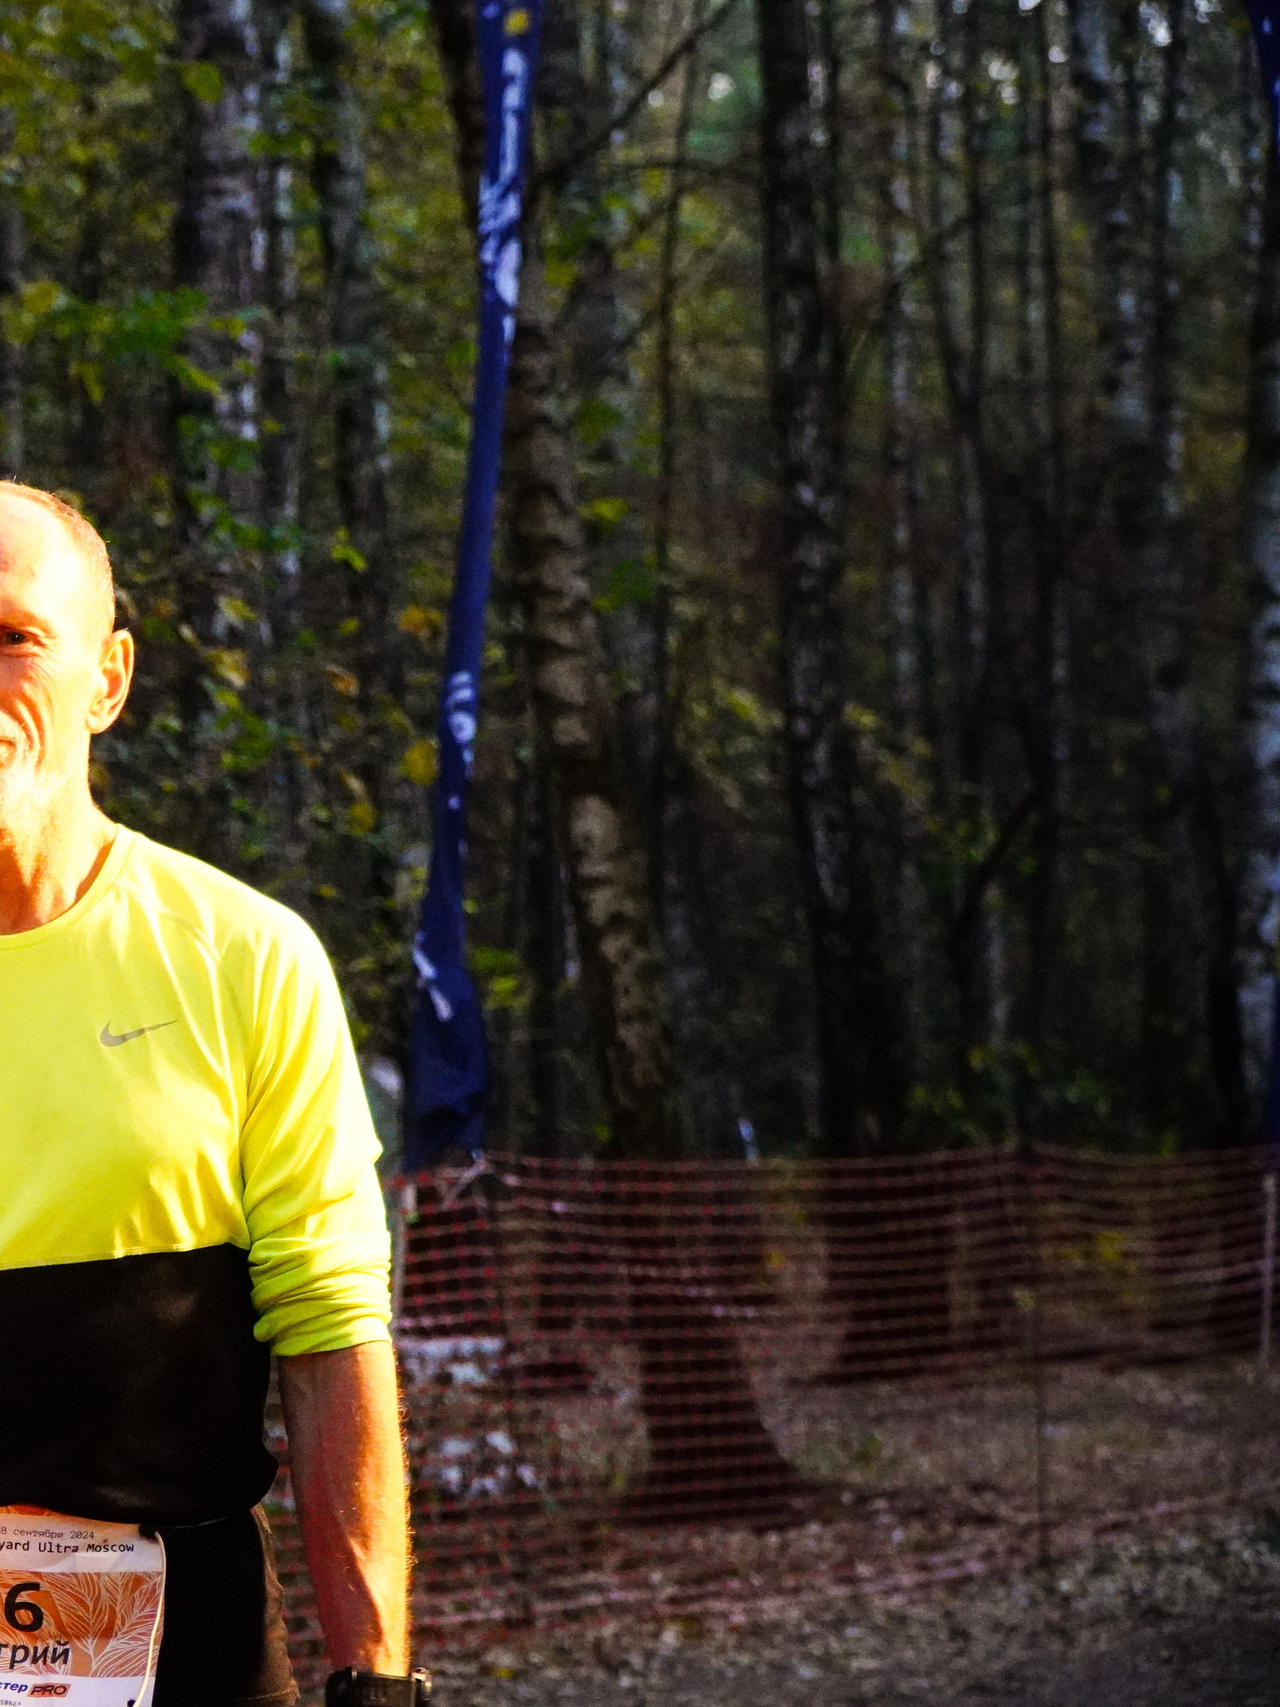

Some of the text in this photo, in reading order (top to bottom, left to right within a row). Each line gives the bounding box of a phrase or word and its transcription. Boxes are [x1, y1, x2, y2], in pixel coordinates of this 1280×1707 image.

[13, 1528, 63, 1539] сентября
[70, 1530, 94, 1540] 2024
[38, 1541, 79, 1553] Ultra
[86, 1543, 134, 1554] Moscow
[31, 1684, 68, 1696] PRO
